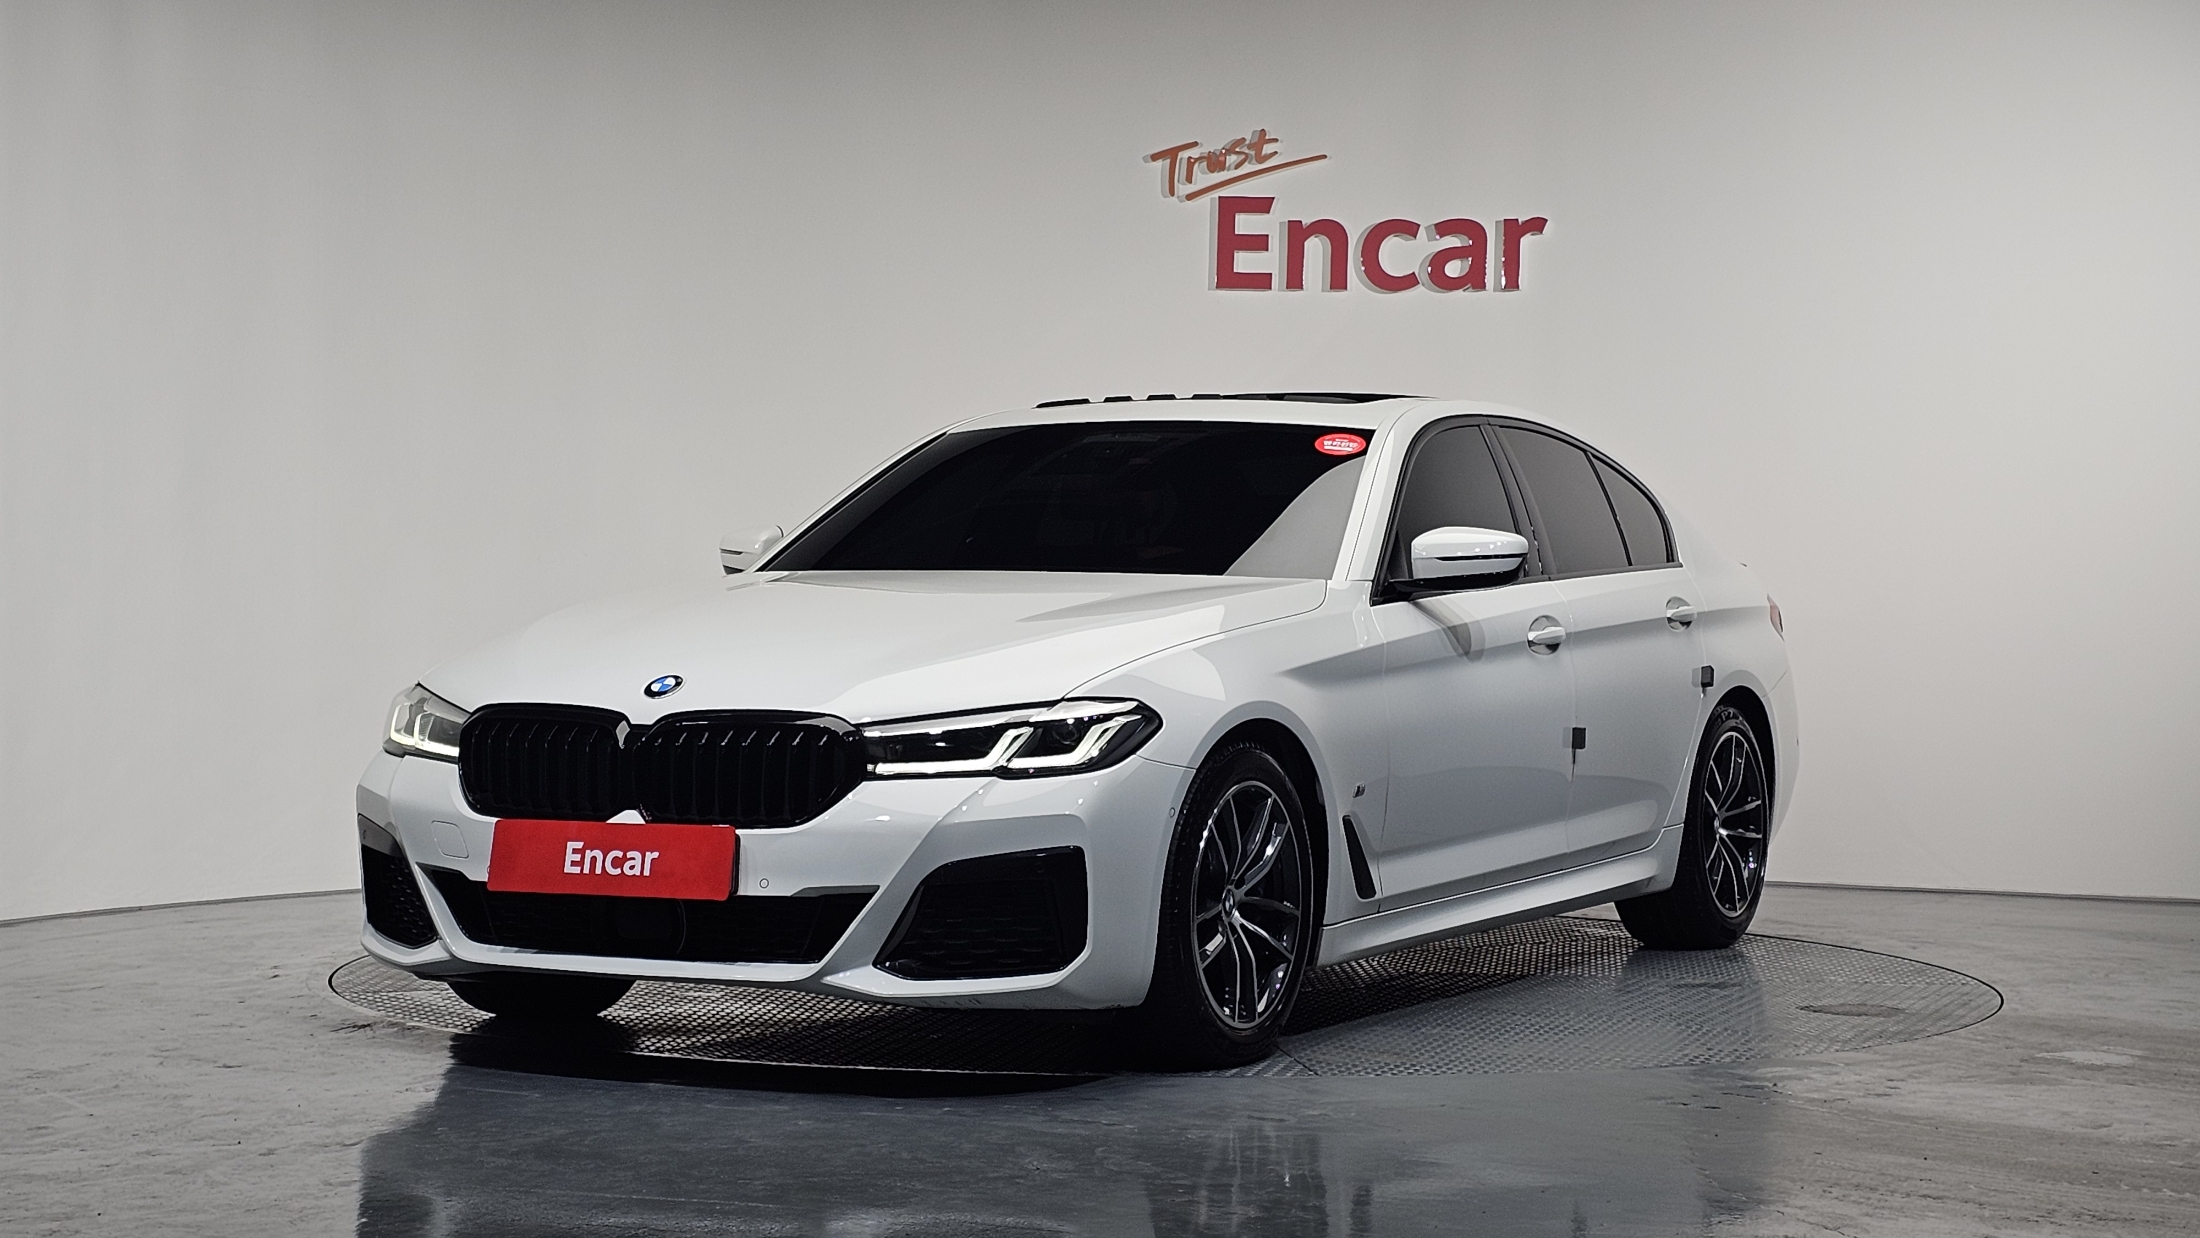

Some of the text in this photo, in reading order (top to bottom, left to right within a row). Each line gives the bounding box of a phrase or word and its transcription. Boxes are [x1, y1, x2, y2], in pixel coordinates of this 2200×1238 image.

[1150, 128, 1279, 197] Trust
[1214, 195, 1548, 291] Encar
[563, 841, 660, 877] Encar
